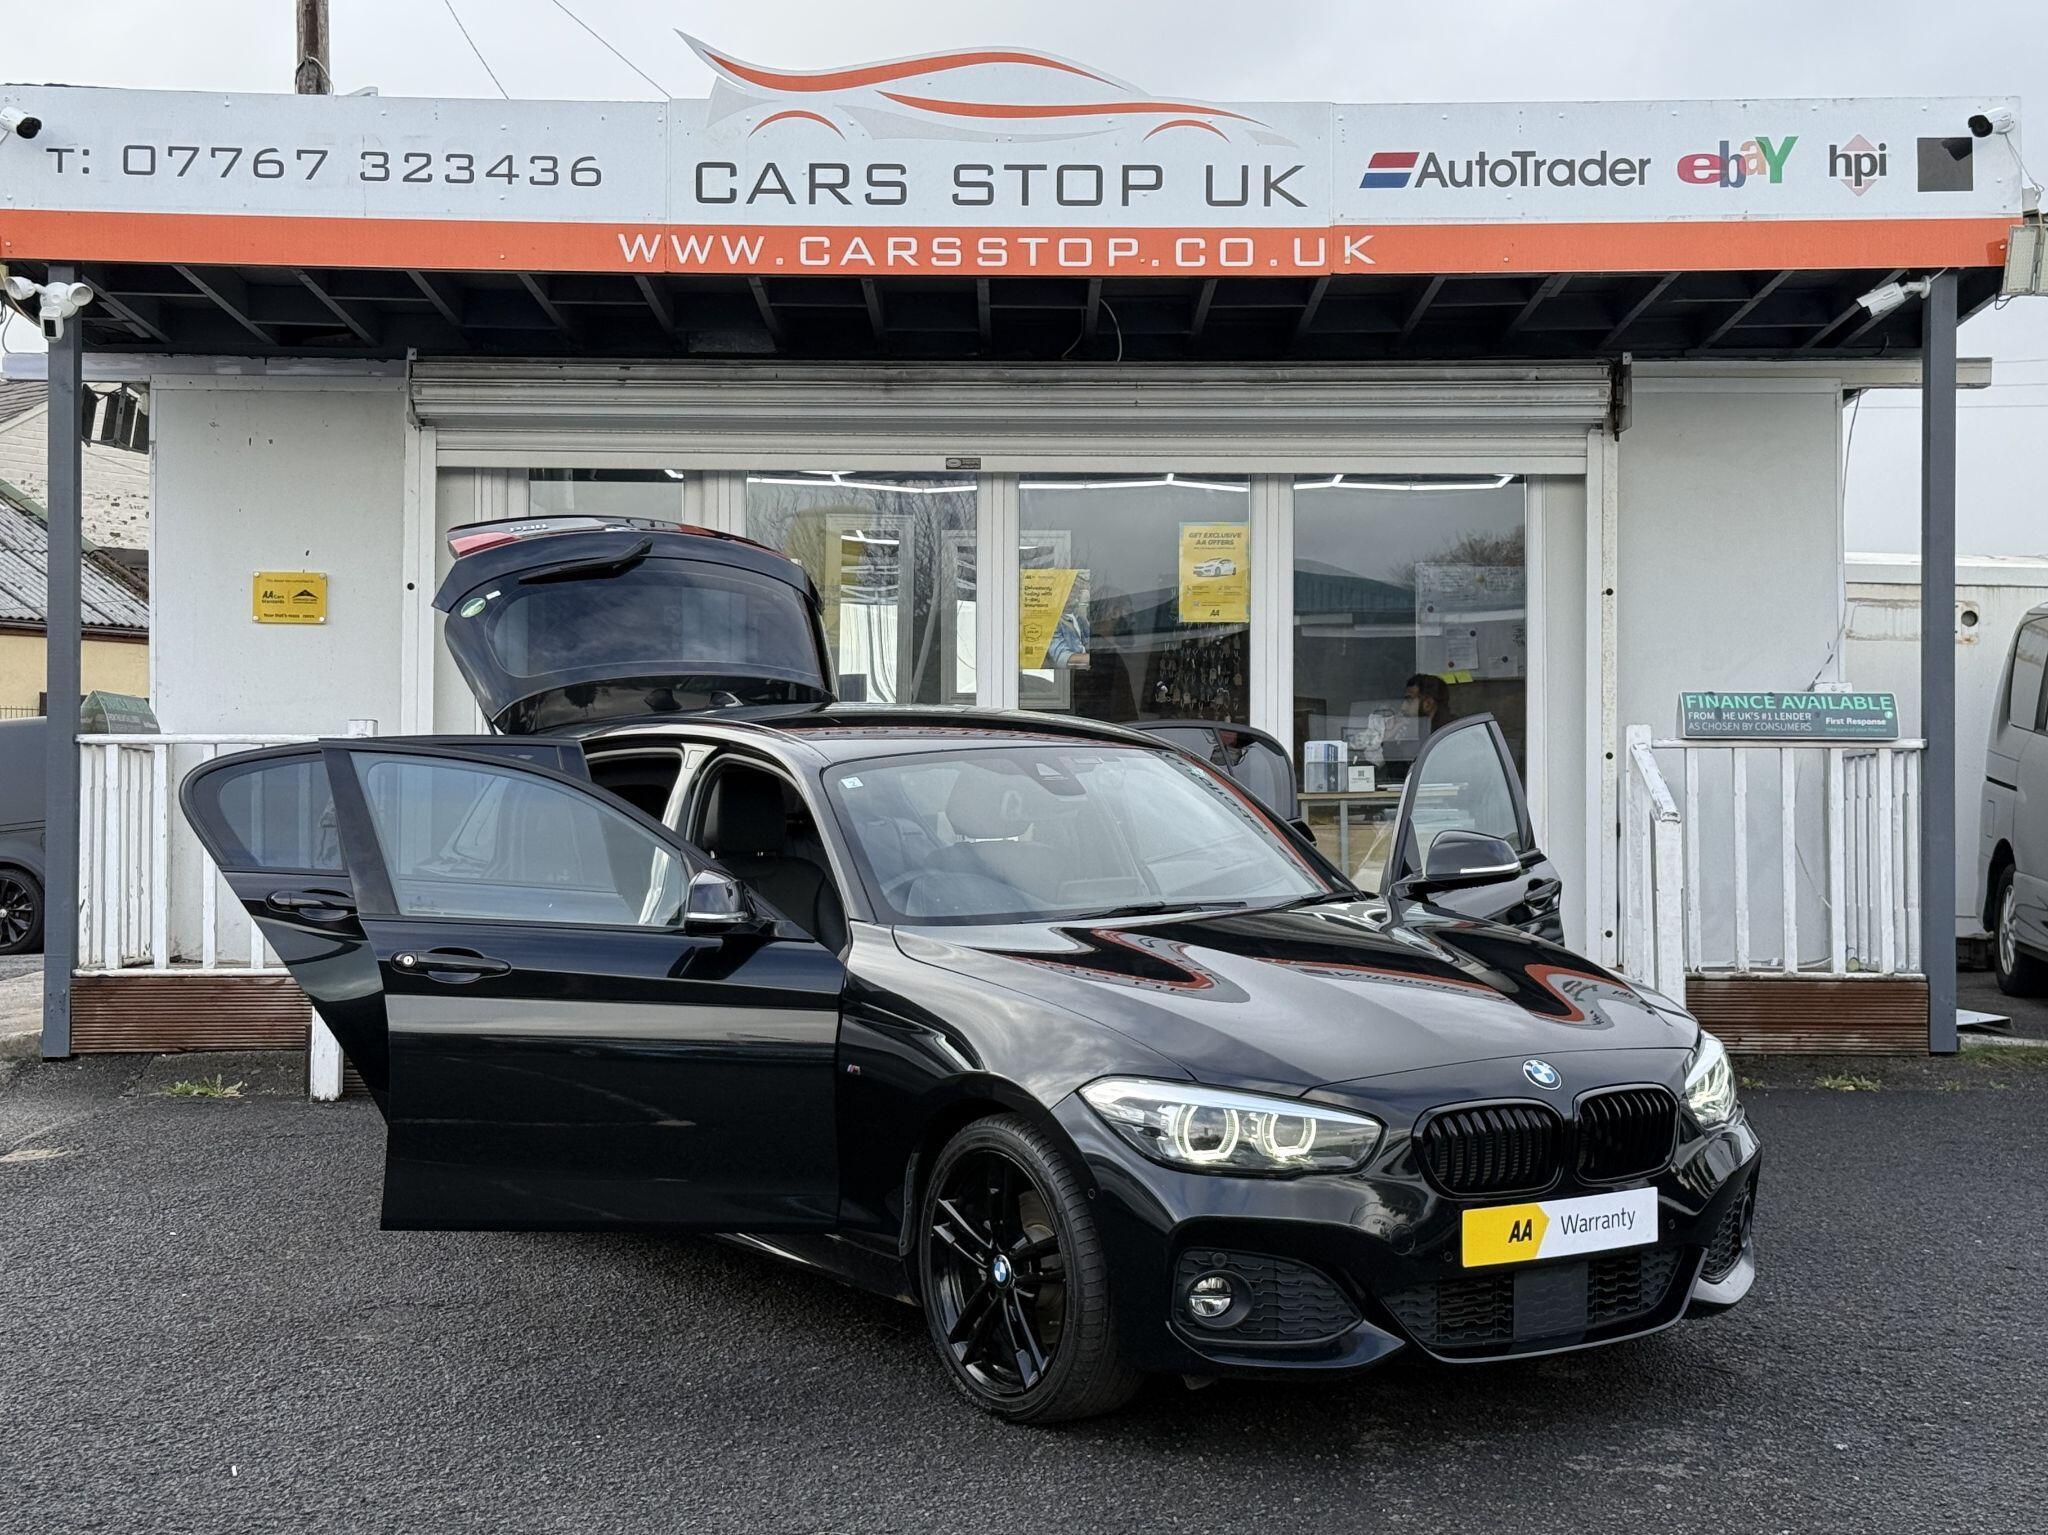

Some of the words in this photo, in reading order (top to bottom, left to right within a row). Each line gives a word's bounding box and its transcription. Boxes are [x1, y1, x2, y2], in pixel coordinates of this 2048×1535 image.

[46, 147, 90, 174] T:
[122, 145, 328, 180] 07767
[360, 151, 602, 187] 323436
[1414, 149, 1652, 188] AutoTrader
[1828, 142, 1887, 188] hpi
[695, 160, 908, 206] CARS
[951, 163, 1164, 208] STOP
[1205, 164, 1309, 208] UK
[617, 231, 1377, 268] WWW.CARSSTOP.CO.UK
[262, 590, 274, 599] AA
[1209, 609, 1220, 617] AA
[1685, 695, 1777, 709] FINANCE
[1781, 695, 1893, 710] AVAILABLE
[1688, 711, 1715, 720] FROM
[1737, 712, 1760, 720] UK'S
[1761, 712, 1772, 720] #1
[1774, 712, 1812, 721] LENDER
[1688, 722, 1701, 730] AS
[1701, 722, 1740, 730] CHOSEN
[1742, 722, 1754, 730] BY
[1754, 722, 1813, 731] CONSUMERS
[1825, 717, 1845, 725] First
[1846, 717, 1887, 726] Response
[1508, 1218, 1533, 1244] AA
[1560, 1206, 1636, 1236] Warranty
